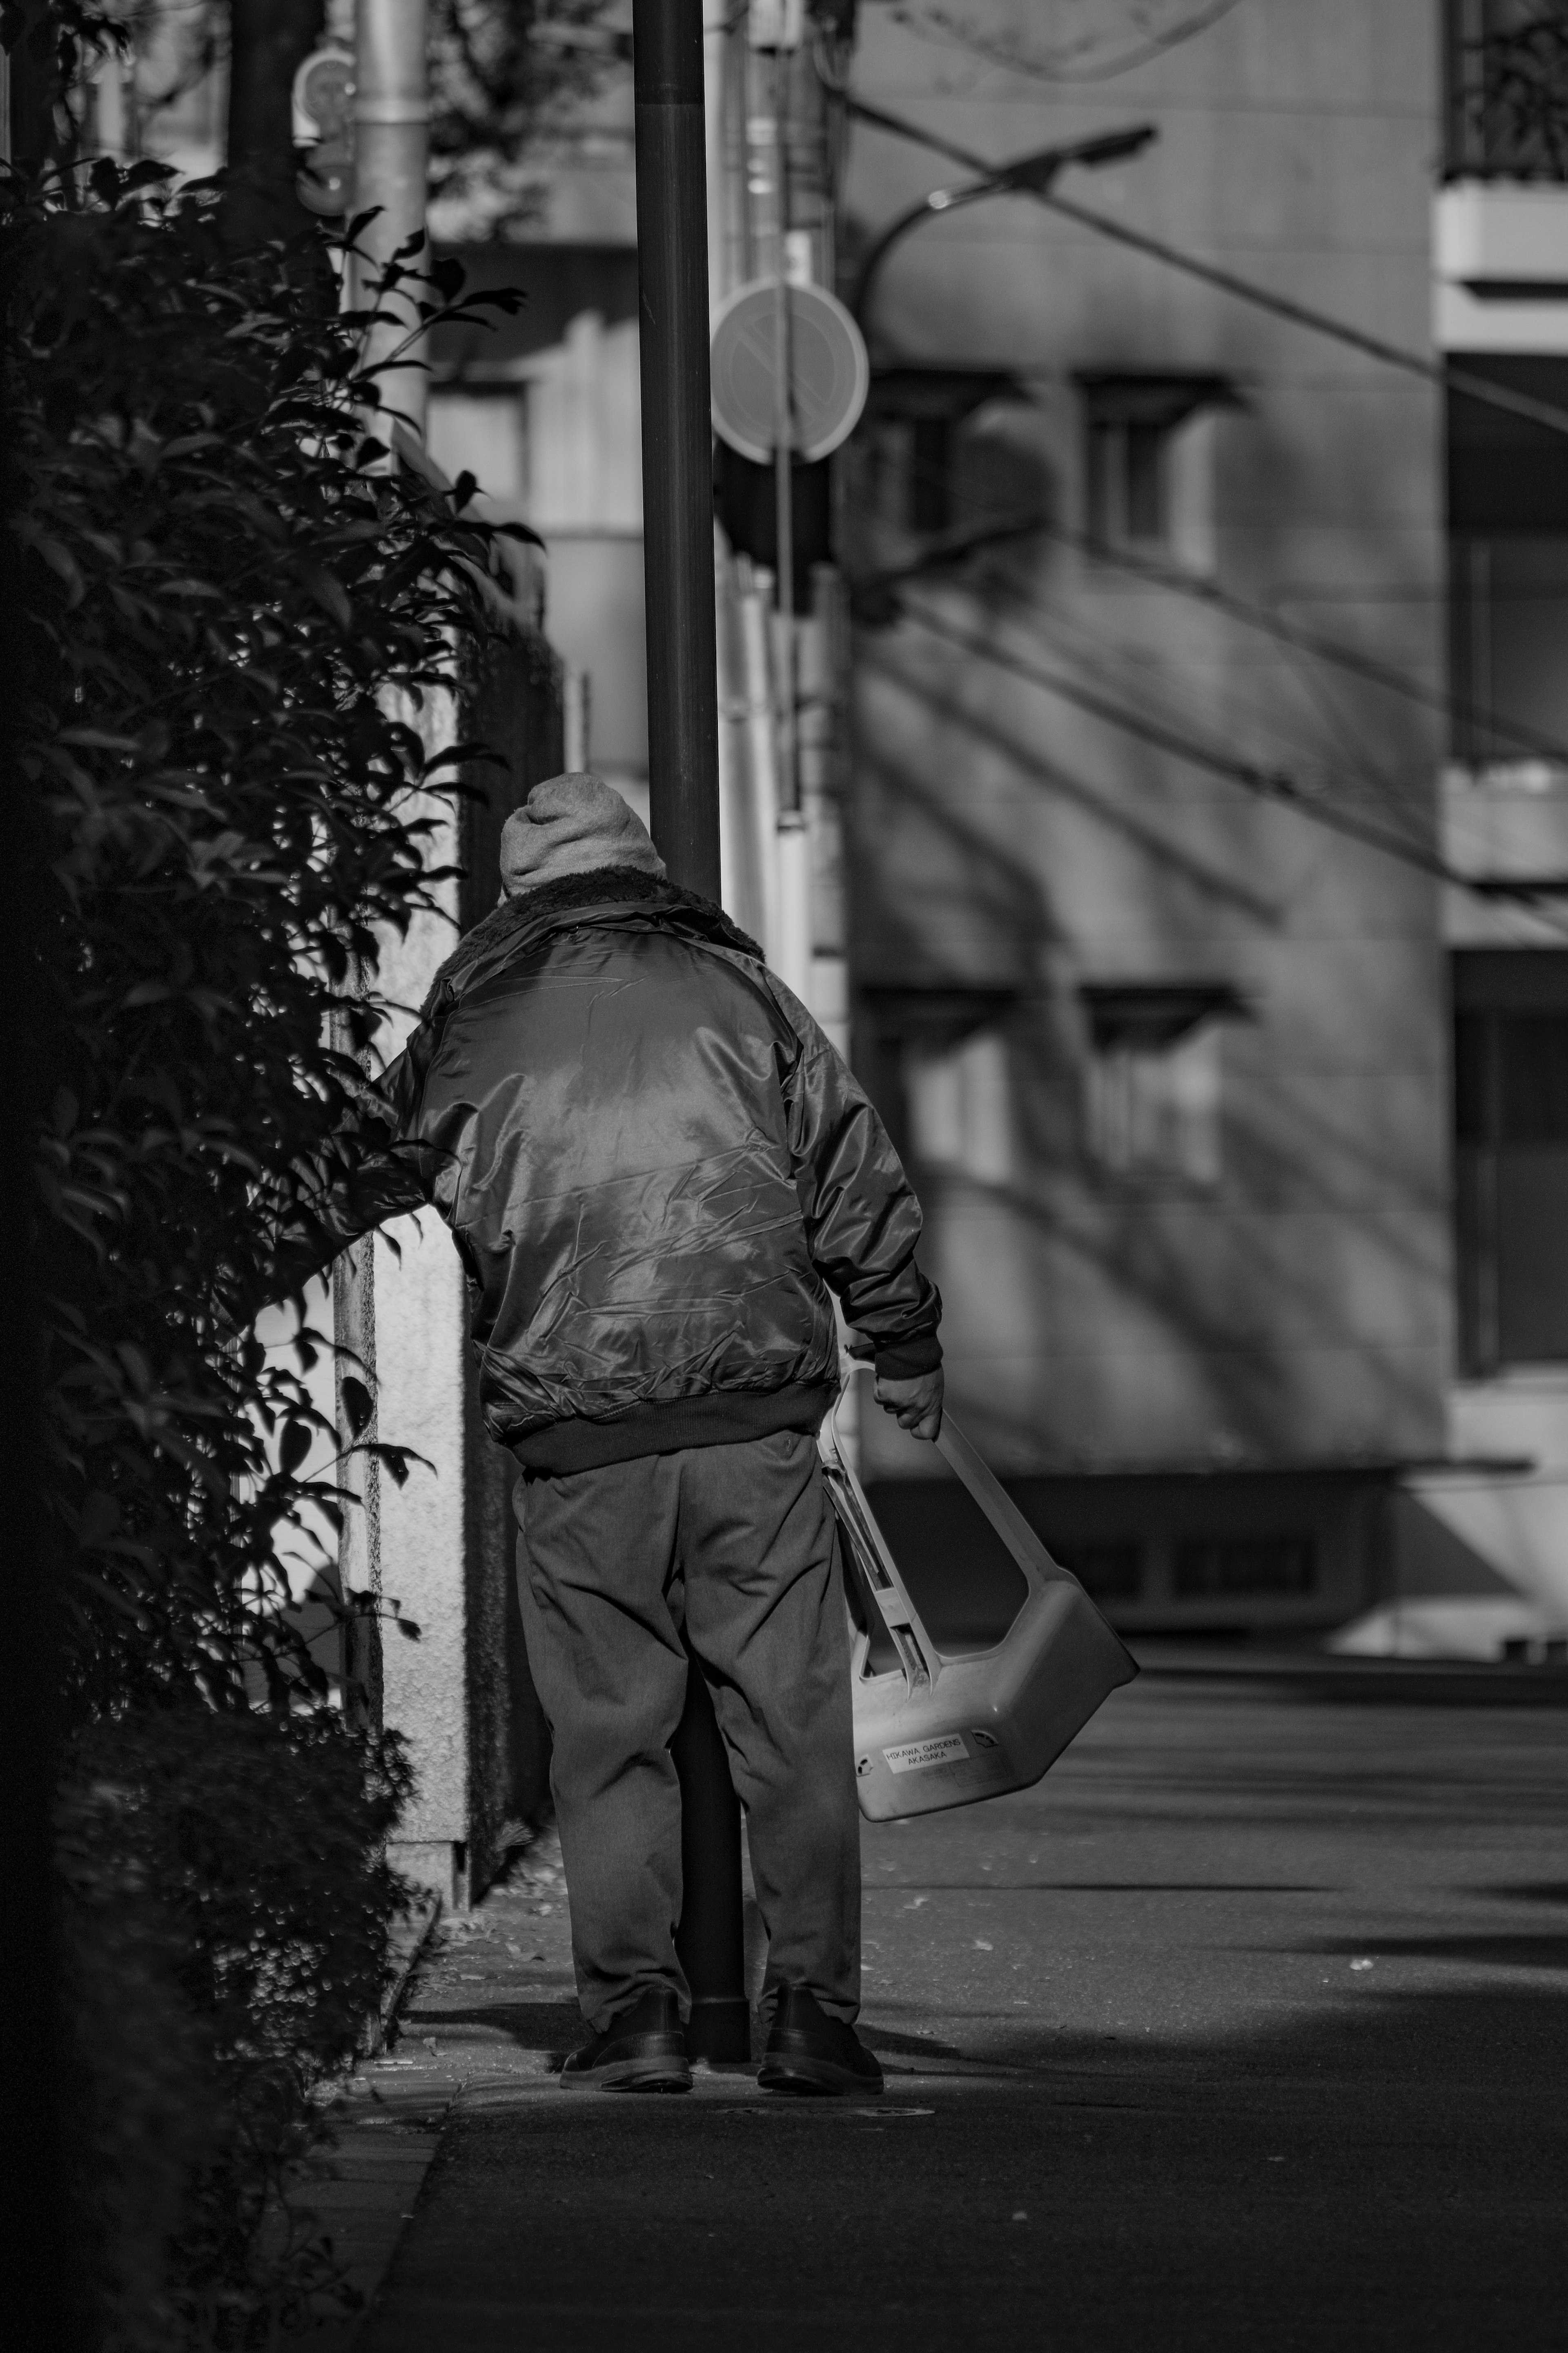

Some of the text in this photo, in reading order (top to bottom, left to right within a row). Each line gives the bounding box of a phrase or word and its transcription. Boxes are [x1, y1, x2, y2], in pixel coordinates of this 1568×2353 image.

[886, 1739, 960, 1760] HIKAWA GARDENS
[908, 1751, 947, 1765] AKASAKA
